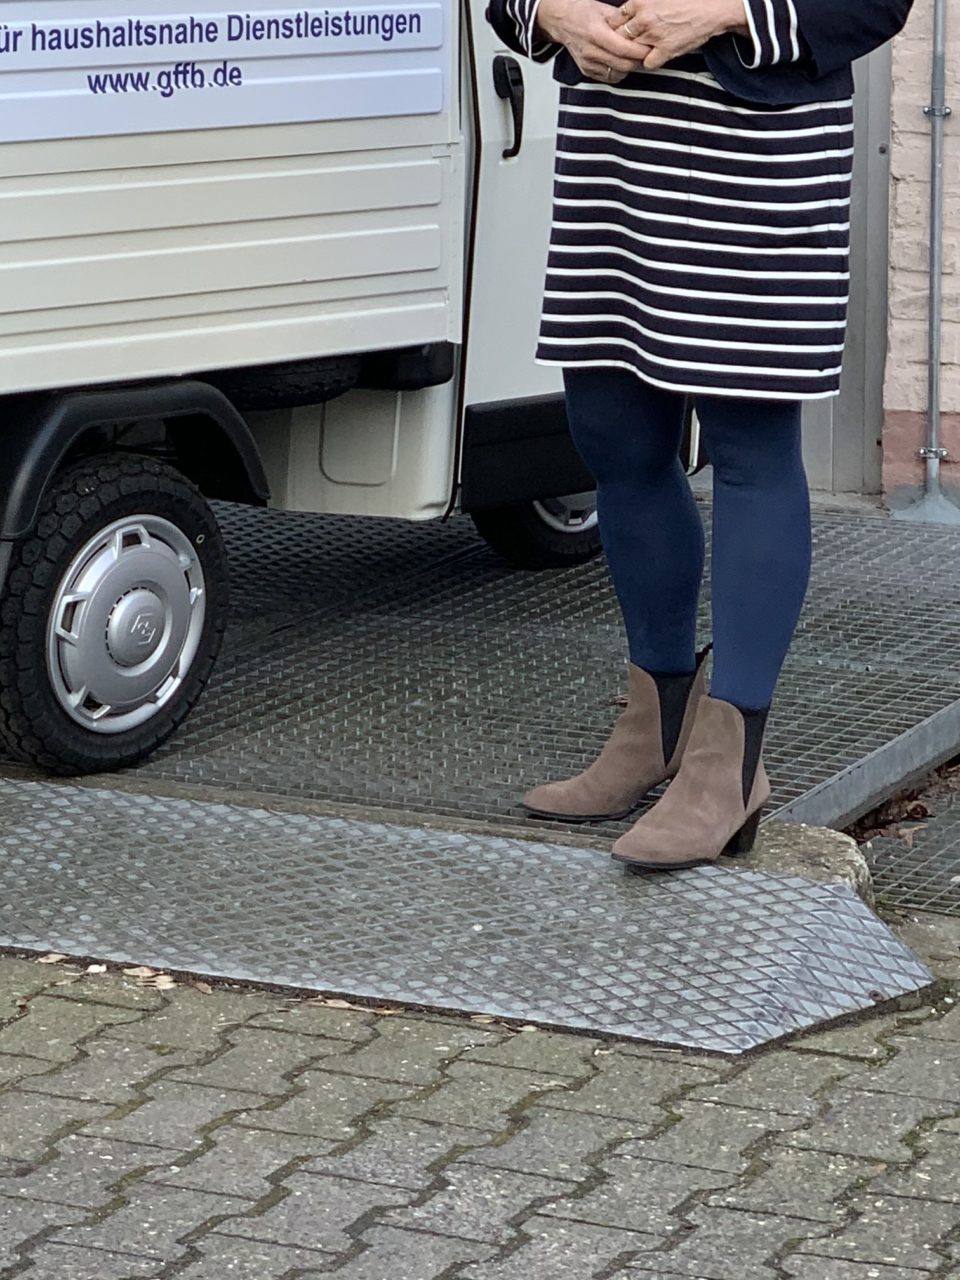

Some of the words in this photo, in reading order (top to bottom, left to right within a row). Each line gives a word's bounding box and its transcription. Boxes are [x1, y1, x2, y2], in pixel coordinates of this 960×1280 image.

[31, 16, 219, 52] haushaltsnahe
[227, 10, 422, 42] Dienstleistungen
[87, 60, 242, 98] www.gffb.de
